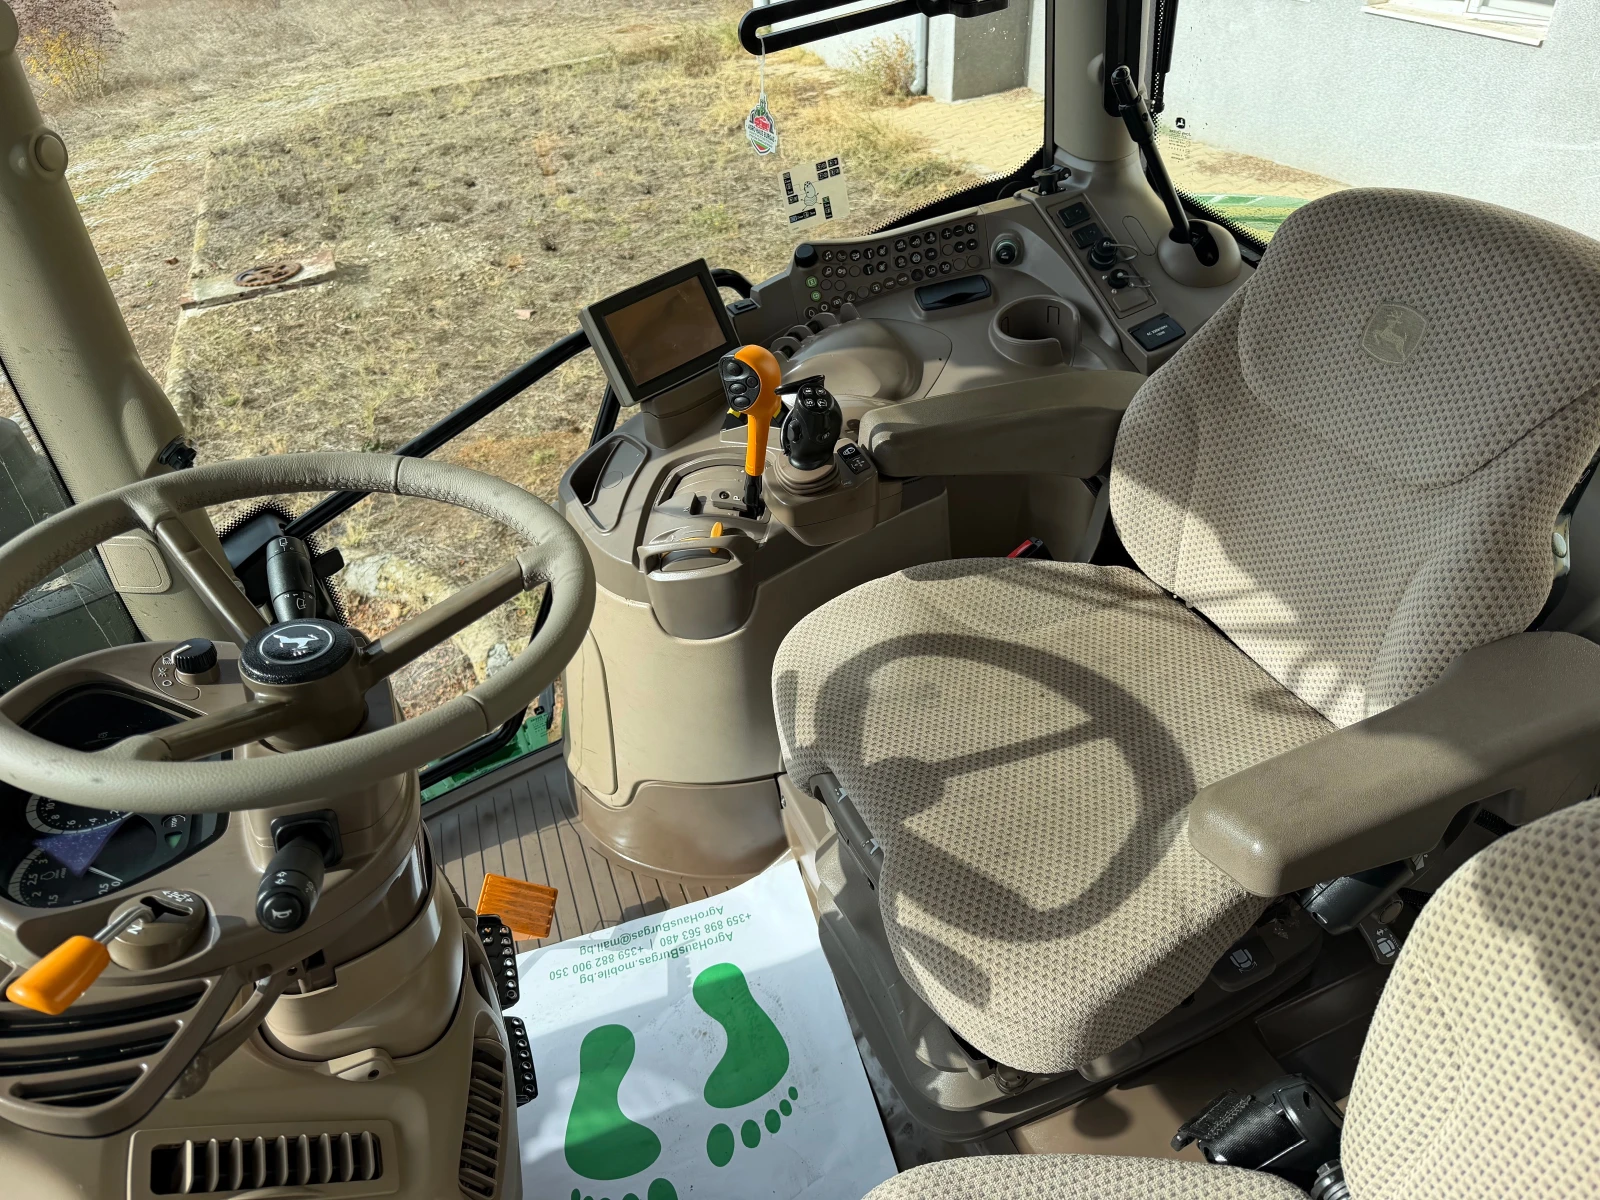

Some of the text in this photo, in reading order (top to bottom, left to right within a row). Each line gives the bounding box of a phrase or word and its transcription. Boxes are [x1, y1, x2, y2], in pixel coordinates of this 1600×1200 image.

[27, 873, 38, 886] 2.5
[47, 894, 59, 906] 1.5
[704, 919, 724, 934] 898
[726, 912, 752, 927] +359
[579, 905, 724, 955] AgroHausBurgas@mail.bg
[682, 926, 701, 941] 563
[659, 931, 679, 947] 480
[579, 931, 733, 984] AgroHausBurgas.mobile.bg
[595, 952, 615, 967] 882
[618, 945, 644, 960] +359
[549, 966, 569, 981] 350
[572, 959, 592, 974] 900
